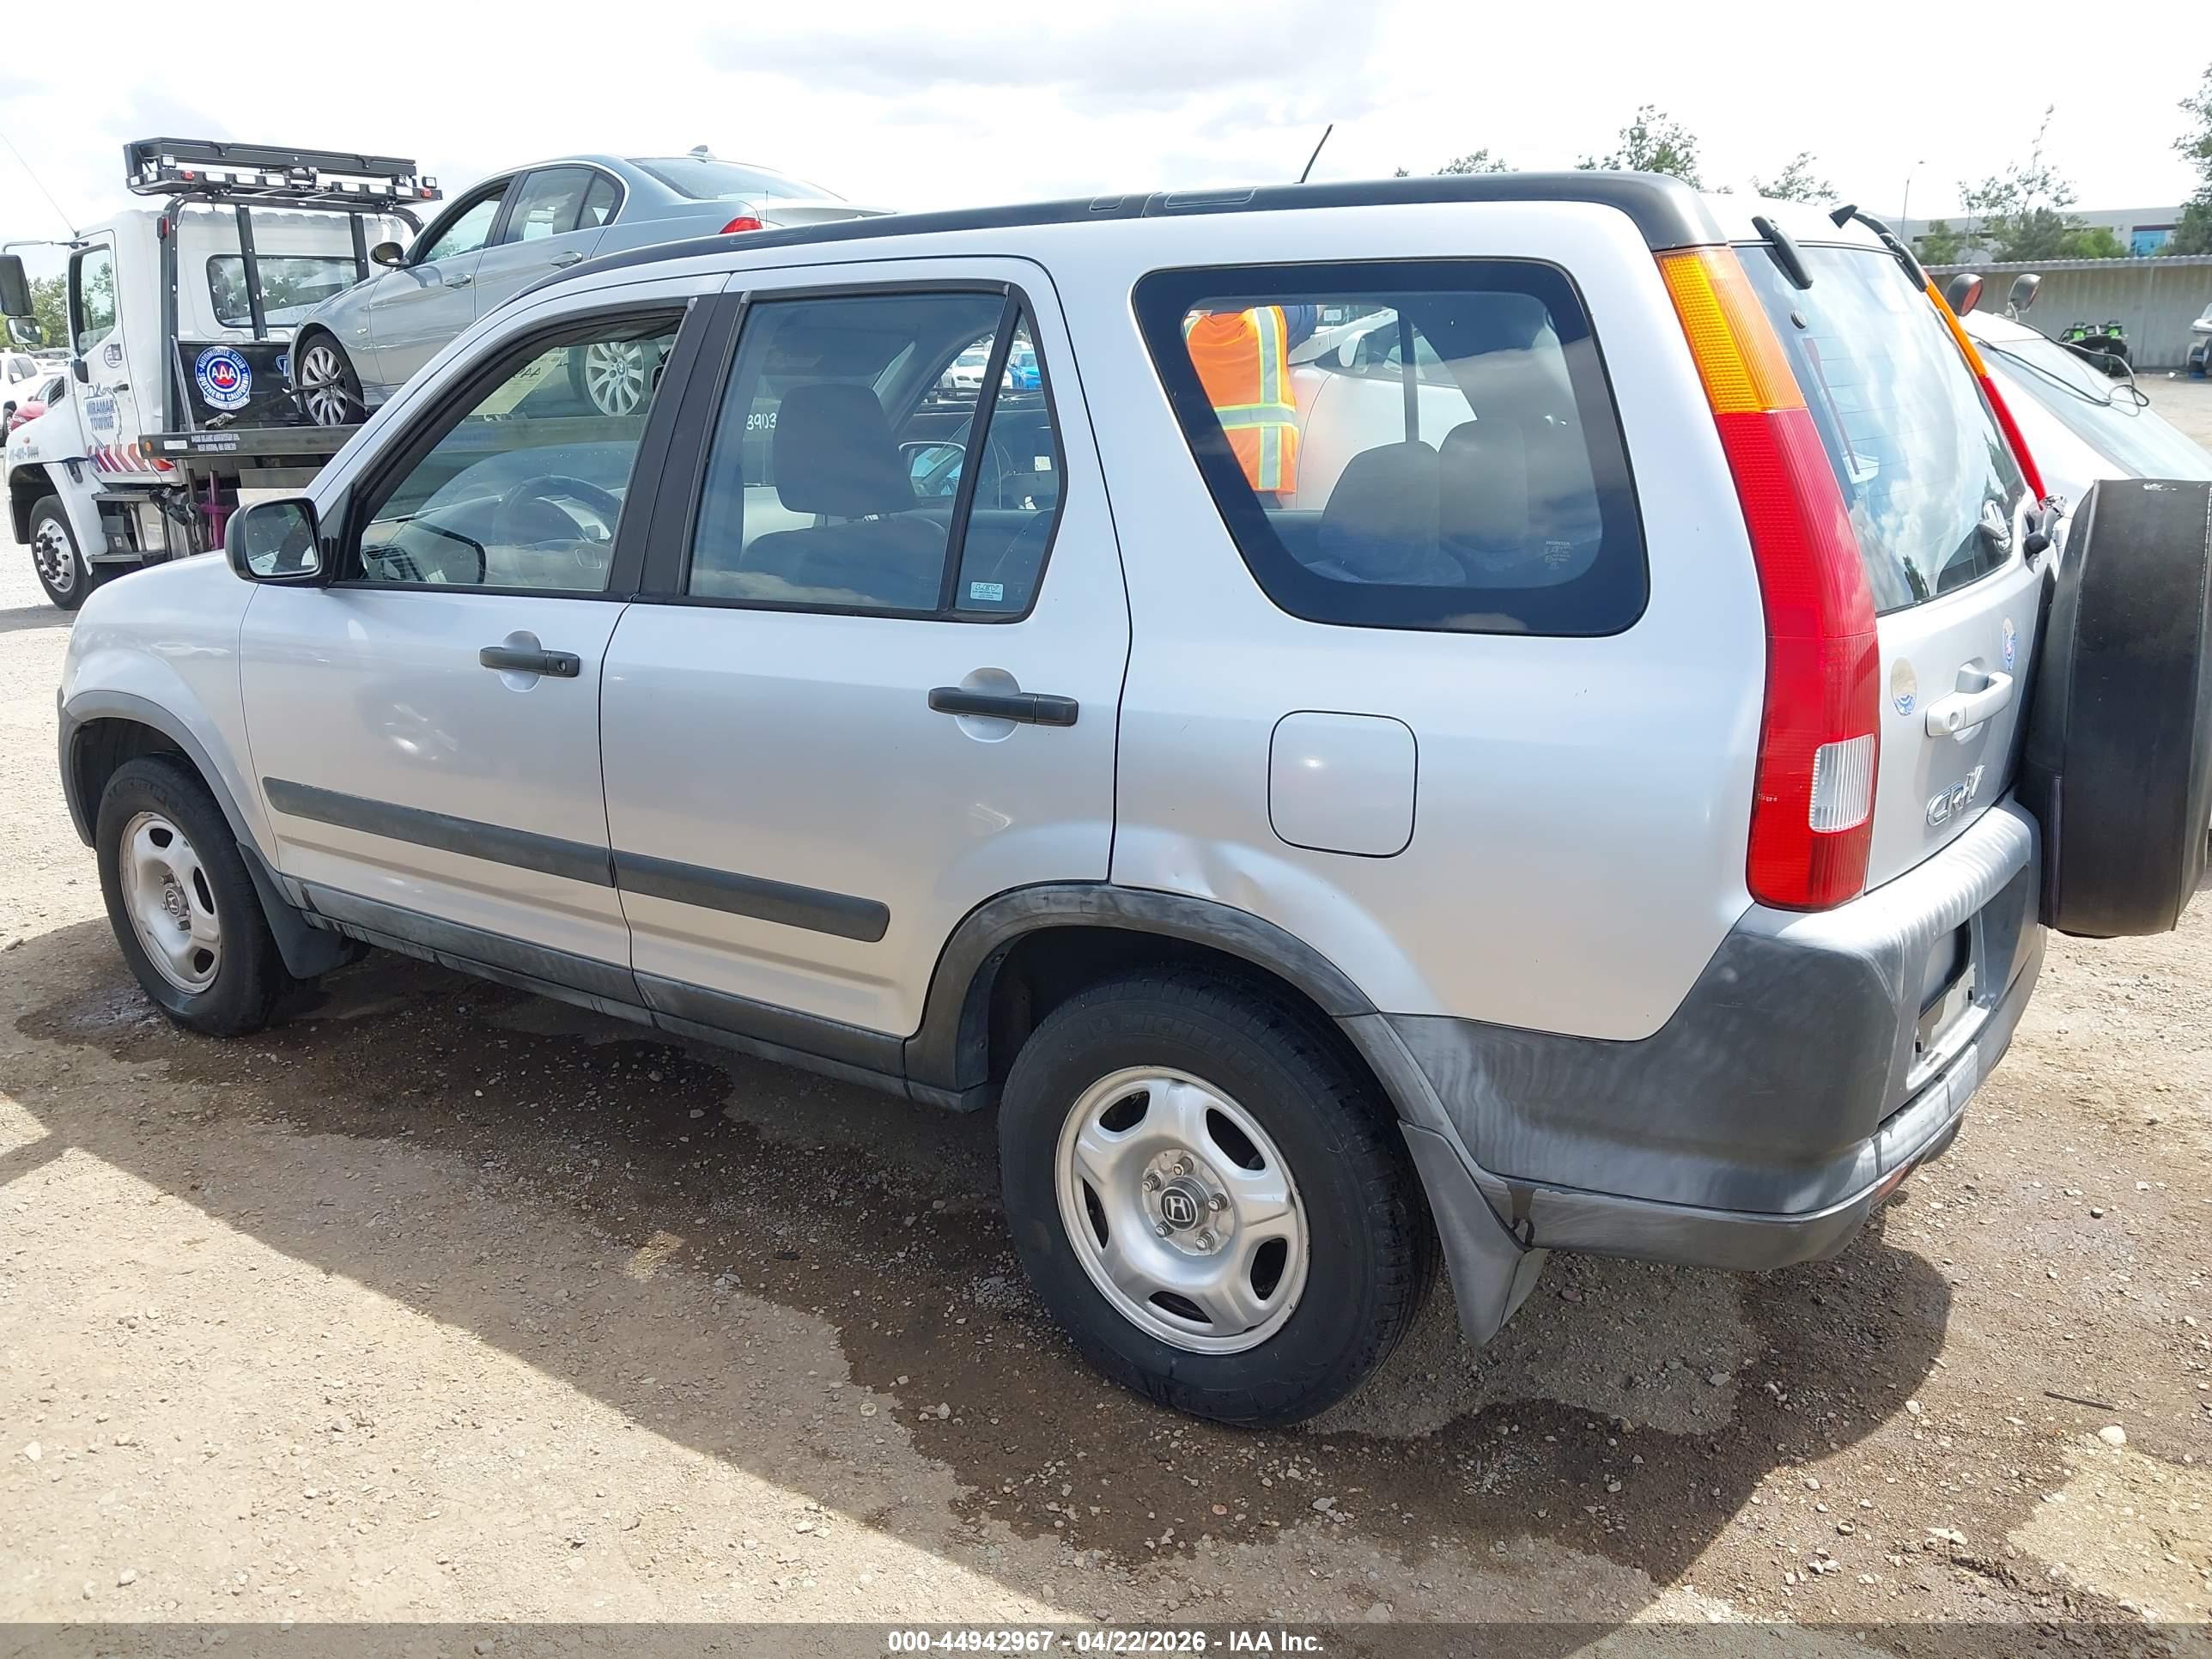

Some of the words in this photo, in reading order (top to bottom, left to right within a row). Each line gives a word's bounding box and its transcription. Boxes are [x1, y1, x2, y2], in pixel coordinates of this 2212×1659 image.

[198, 349, 230, 369] AUTOMOBILE
[231, 353, 246, 369] CLUB
[211, 365, 237, 380] AAA
[198, 372, 226, 401] SOUTHERN
[226, 372, 249, 401] CALIFORNIA
[87, 398, 116, 415] MIRAMAR
[89, 416, 114, 431] TOWING
